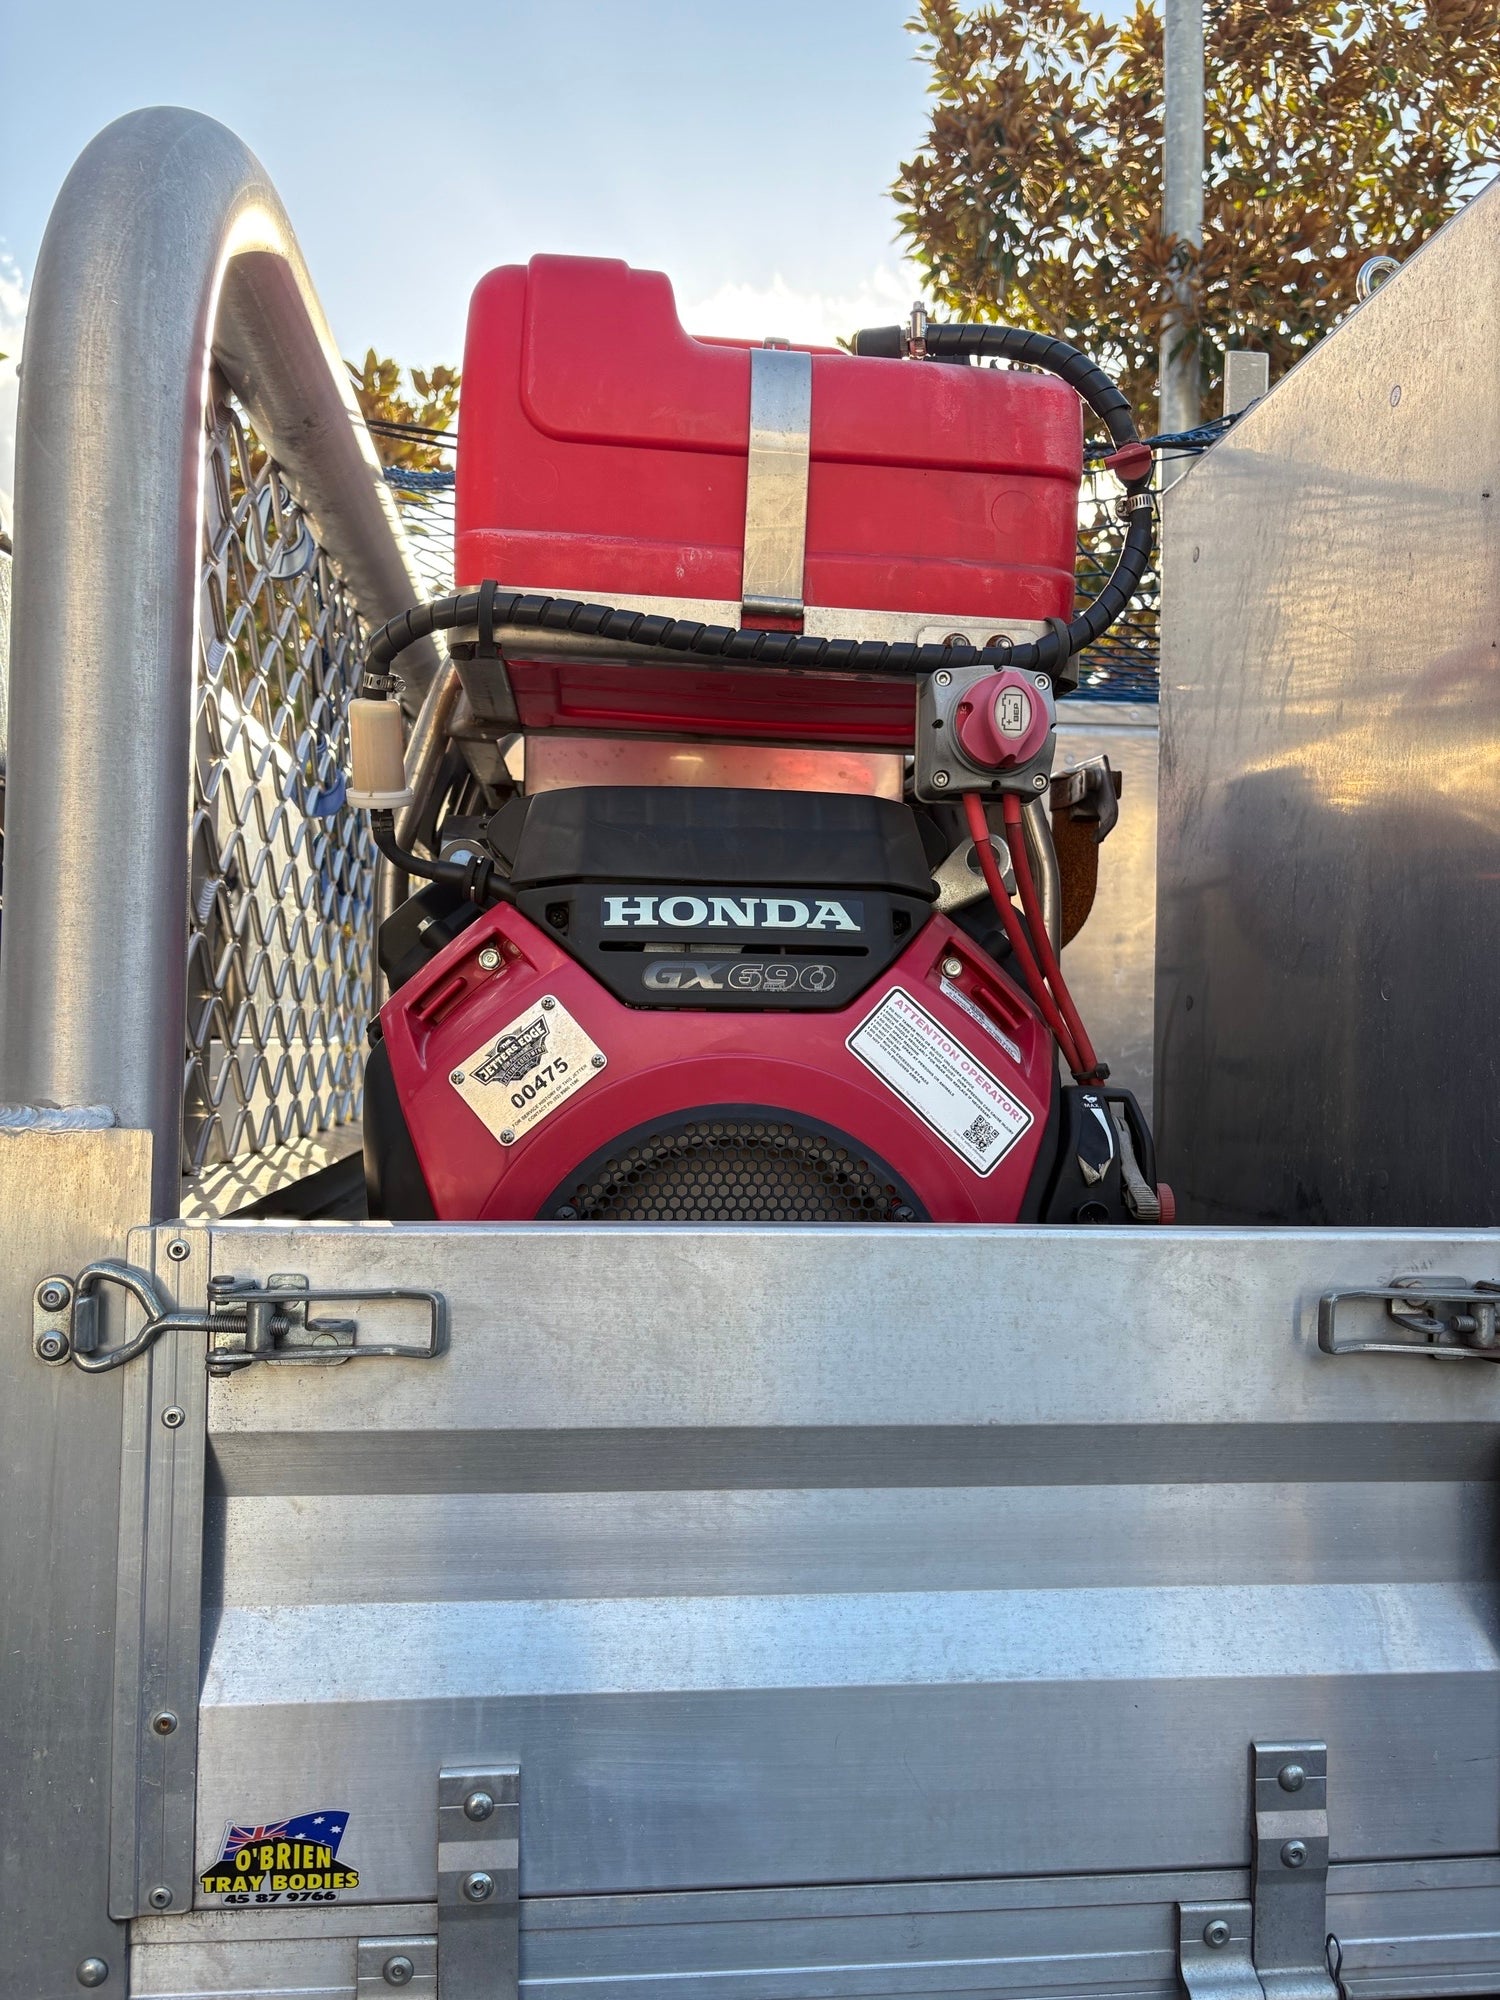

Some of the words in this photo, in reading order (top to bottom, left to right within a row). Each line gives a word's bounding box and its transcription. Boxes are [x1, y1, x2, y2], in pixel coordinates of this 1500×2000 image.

[603, 896, 861, 931] HONDA
[643, 961, 837, 991] GX690
[479, 1043, 518, 1078] JETTERS
[518, 1023, 546, 1046] EDGE
[501, 1038, 512, 1050] THE
[874, 1032, 883, 1041] NOT
[882, 1039, 891, 1048] RUN
[895, 1052, 915, 1071] EXCESSIVE
[877, 1029, 886, 1038] NOT
[884, 1036, 894, 1045] RUN
[884, 1022, 892, 1030] NOT
[891, 1029, 904, 1041] SPRAY
[902, 1039, 919, 1056] MACHINE
[893, 1011, 902, 1019] NOT
[901, 1018, 916, 1033] TAMPER
[914, 1031, 925, 1042] WITH
[929, 1045, 944, 1059] ADJUST
[871, 1036, 880, 1044] NOT
[890, 1054, 909, 1073] ENCLOSED
[908, 1071, 921, 1084] AREAS
[880, 1025, 889, 1034] NOT
[888, 1032, 902, 1046] DIRECT
[900, 1044, 913, 1057] SPRAY
[916, 1060, 934, 1077] PERSONS
[938, 1080, 954, 1097] ANIMALS
[885, 1010, 899, 1023] ENGINE
[898, 1022, 910, 1034] SPEED
[913, 1036, 927, 1050] PRESET
[933, 1056, 942, 1064] NOT
[941, 1063, 956, 1078] ADJUST
[965, 1087, 983, 1105] SPEEDING
[982, 1103, 991, 1112] CAN
[893, 1024, 908, 1039] NOZZLE
[907, 1037, 928, 1058] REGULARLY
[926, 1056, 935, 1065] FOR
[952, 1080, 968, 1097] REPLACE
[970, 1099, 991, 1119] NECESSARY
[894, 998, 959, 1062] ATTENTION
[959, 1061, 1022, 1122] OPERATOR!
[510, 1057, 568, 1108] 00475
[512, 1118, 522, 1128] FOR
[520, 1104, 539, 1120] SERVICE
[537, 1089, 556, 1106] HISTORY
[561, 1076, 572, 1086] THIS
[570, 1063, 587, 1078] JETTER
[527, 1104, 547, 1122] CONTACT
[235, 1842, 332, 1872] O'BRIEN
[202, 1873, 264, 1893] TRAY
[272, 1871, 359, 1891] BODIES
[225, 1894, 250, 1904] 45
[255, 1893, 281, 1903] 87
[287, 1891, 337, 1902] 9766
